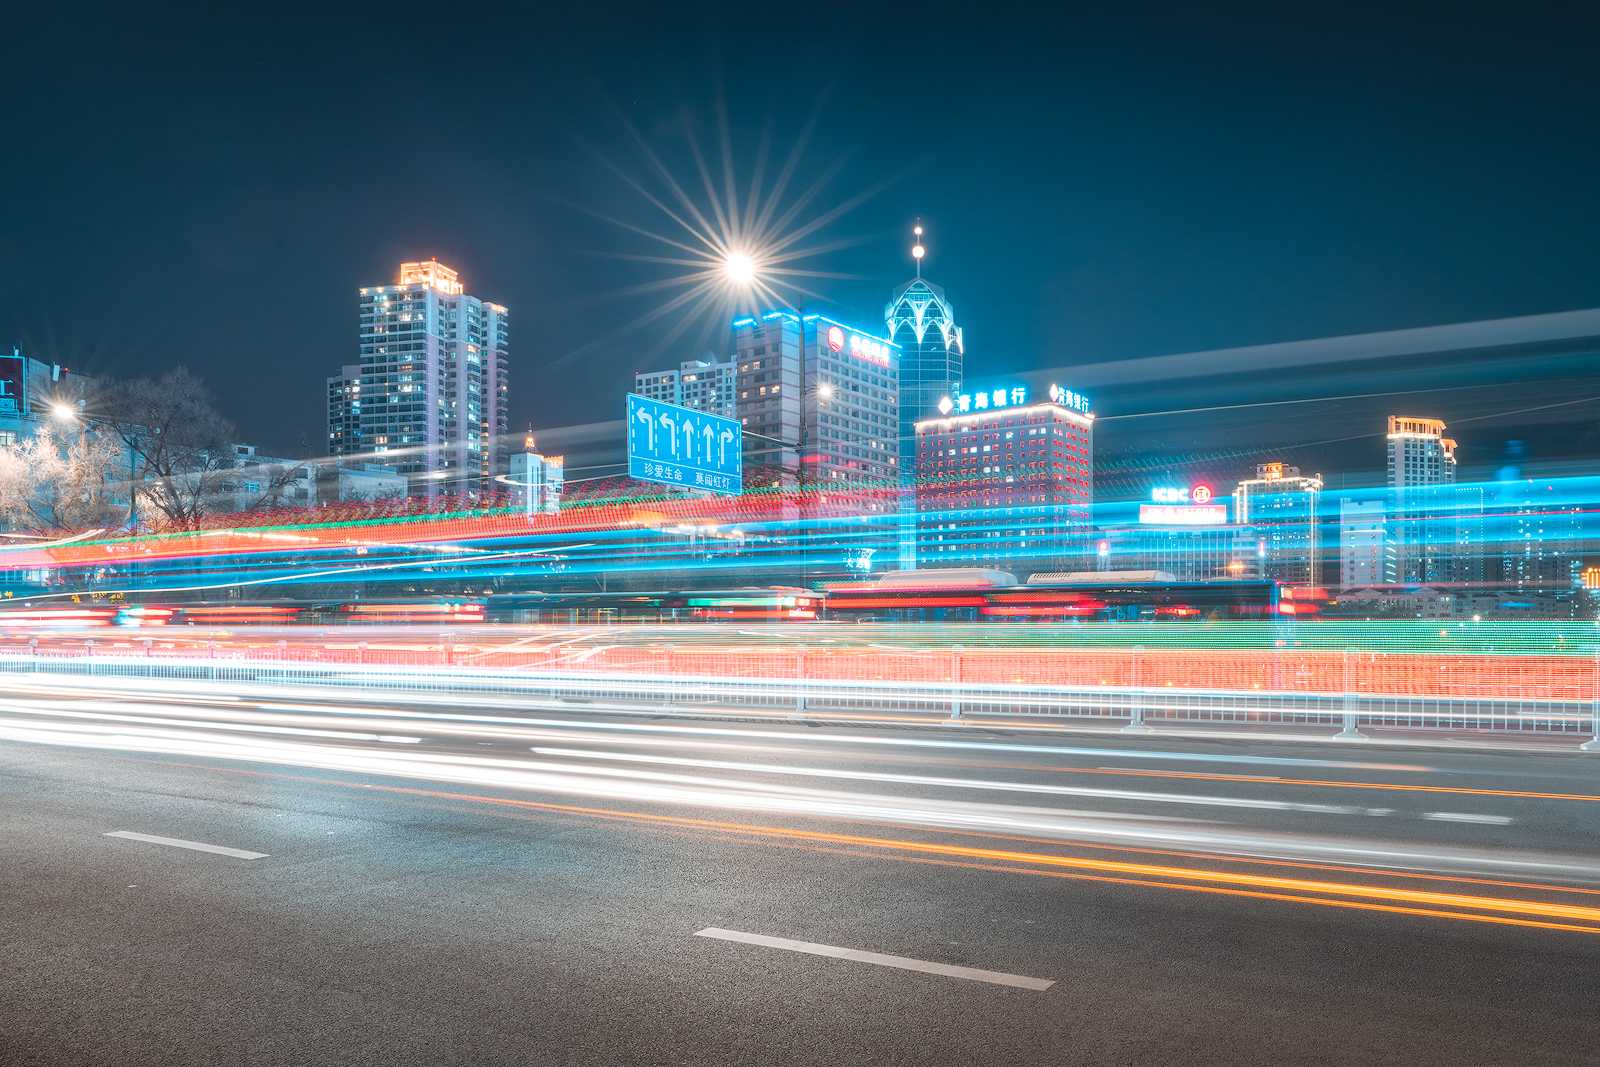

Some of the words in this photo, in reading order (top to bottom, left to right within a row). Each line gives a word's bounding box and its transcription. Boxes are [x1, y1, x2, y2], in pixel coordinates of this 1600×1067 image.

[644, 463, 683, 481] 珍爱生命
[1152, 488, 1189, 502] ICBC
